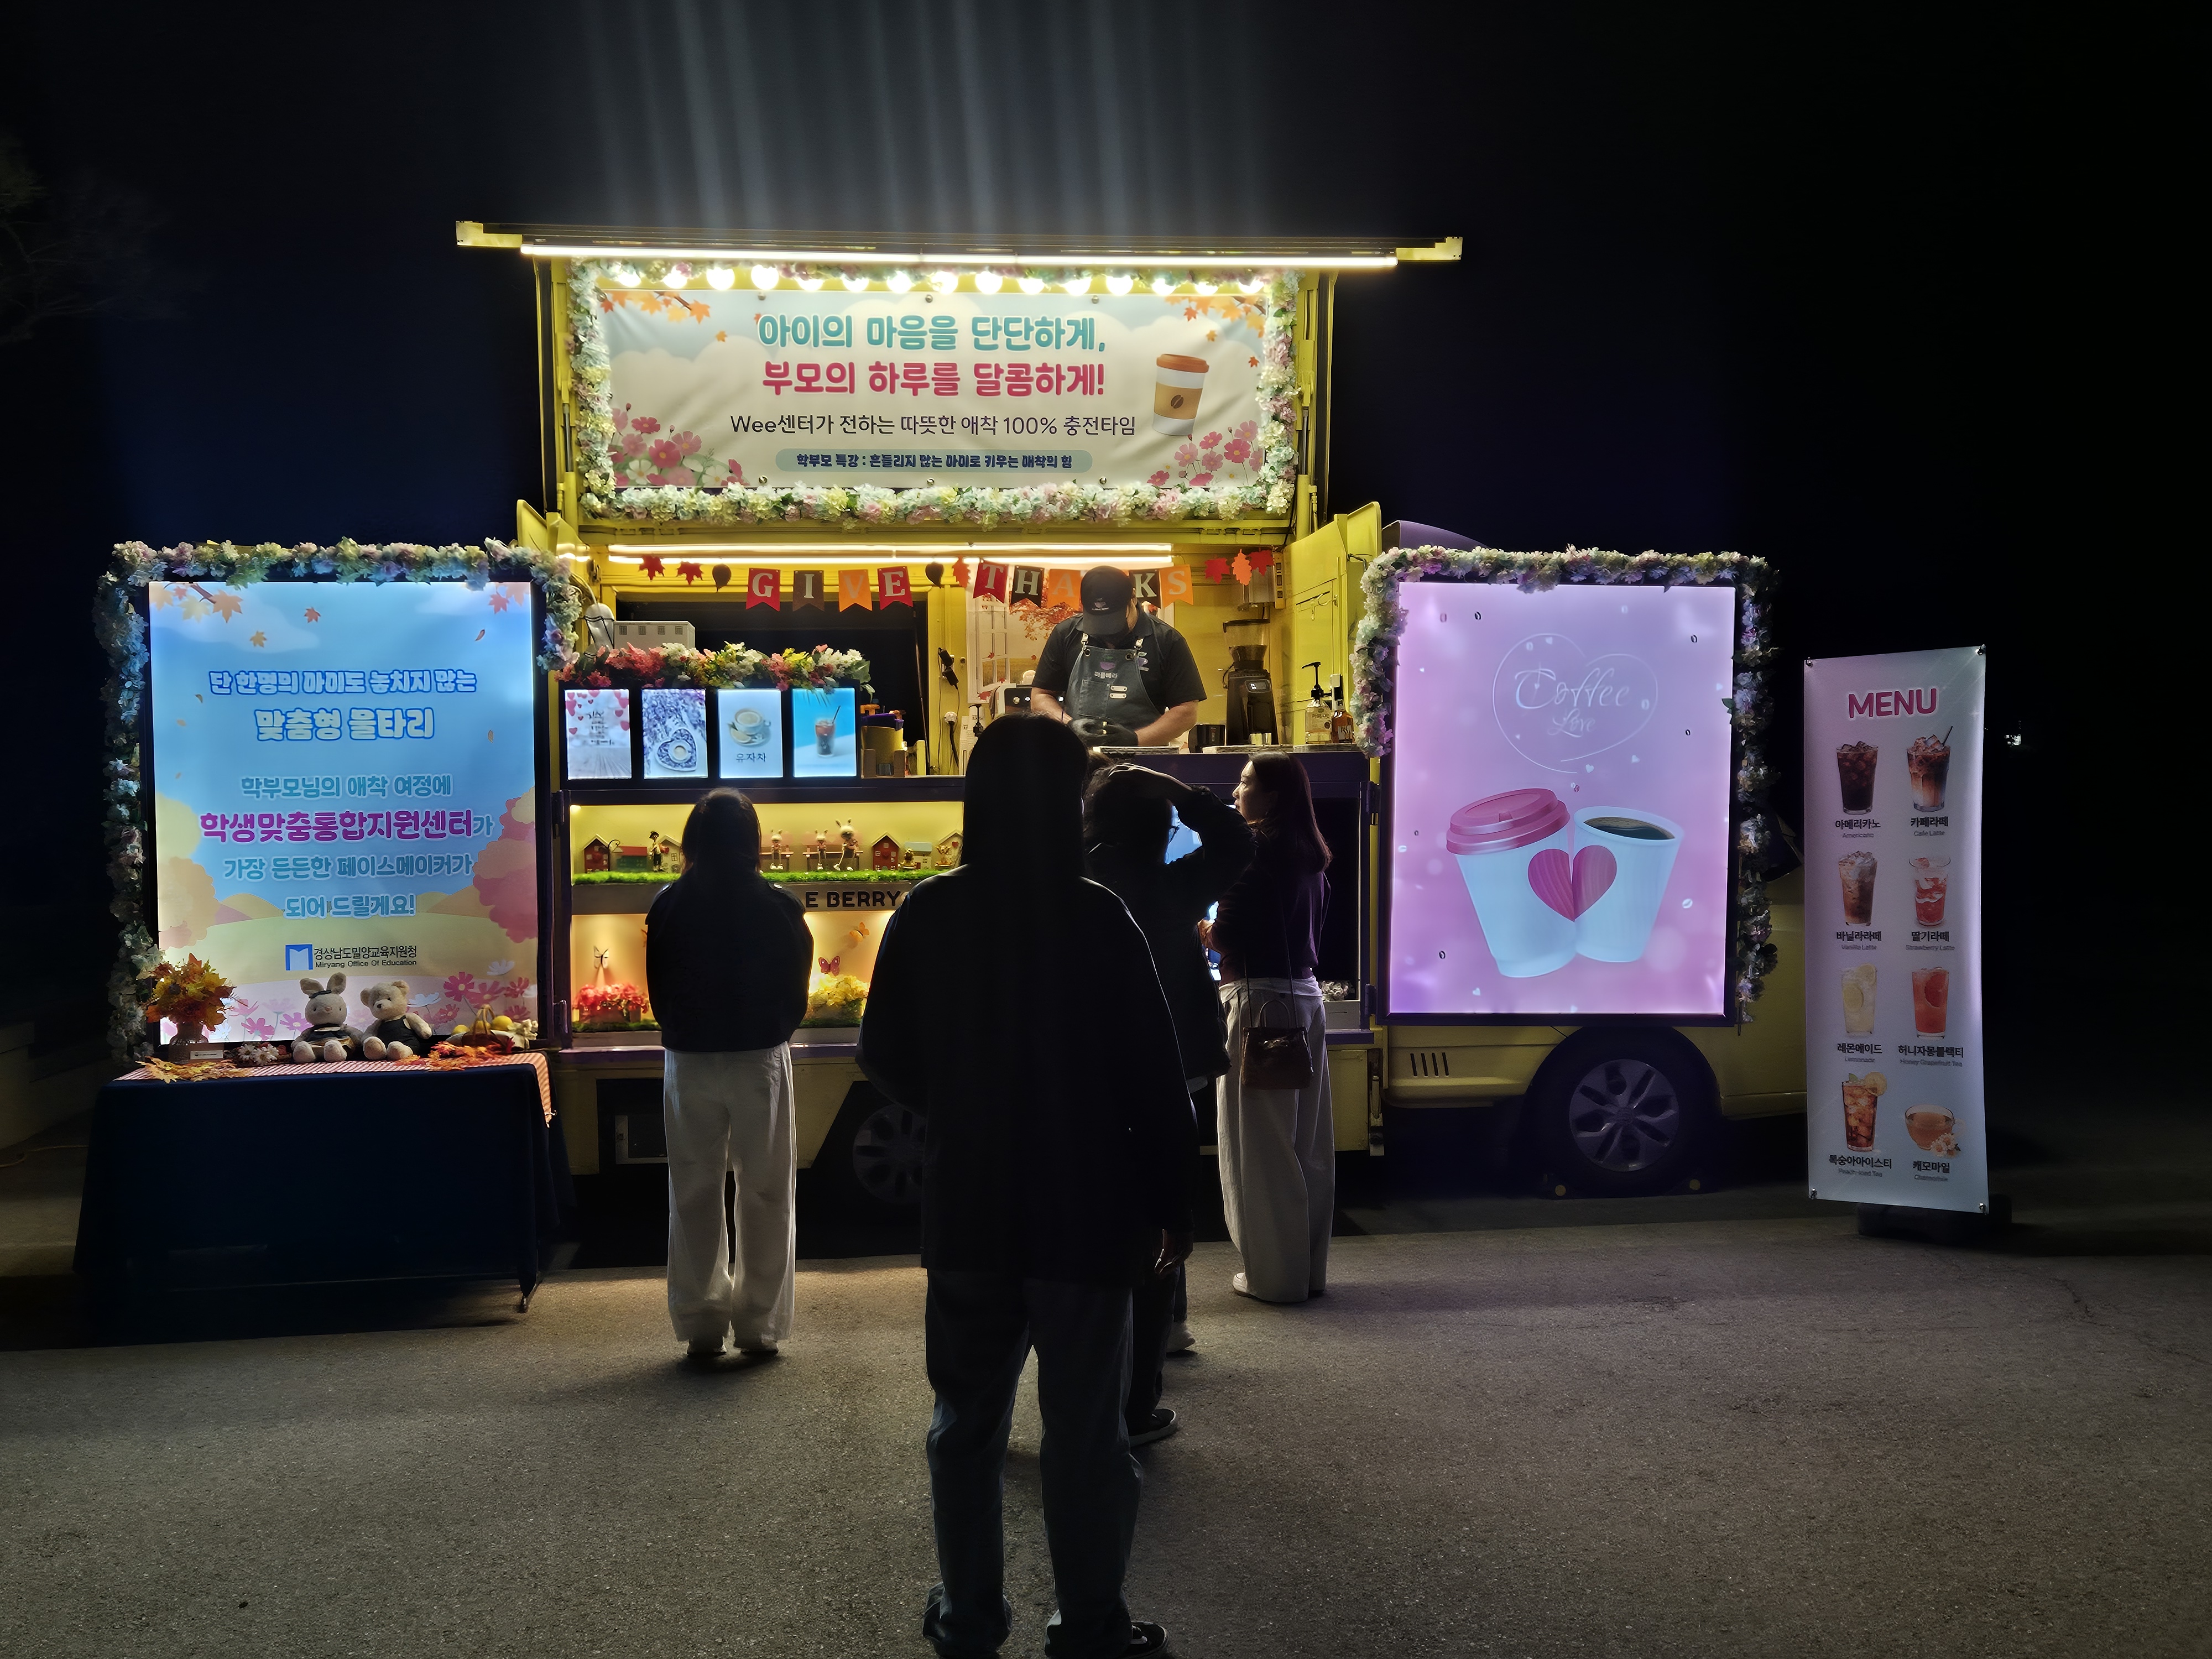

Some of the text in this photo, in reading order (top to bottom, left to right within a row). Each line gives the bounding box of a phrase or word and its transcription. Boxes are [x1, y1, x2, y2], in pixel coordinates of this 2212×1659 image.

[759, 314, 1105, 352] 아이의 마음을 단단하게,
[763, 361, 1104, 397] 부모의 하루를 달콤하게!
[730, 415, 1135, 436] Wee센터가 전하는 따뜻한 애착 100% 충전타임
[796, 453, 832, 467] 학부모
[836, 453, 859, 467] 특강
[870, 453, 916, 468] 흔들리지
[920, 454, 942, 468] 않는
[946, 455, 981, 468] 아이로
[984, 455, 1019, 468] 키우는
[1022, 455, 1057, 468] 애착의
[1061, 455, 1072, 468] 힘
[753, 563, 1187, 599] GIVE THAKS
[208, 669, 477, 695] 단 한명의 아이도 놓치지 않는
[1515, 667, 1630, 709] Coffee
[1848, 687, 1937, 718] MENU
[254, 707, 435, 741] 맞춤형 울타리
[1548, 708, 1595, 738] Love
[241, 774, 452, 799] 학부모님의 애착 여정에
[200, 809, 494, 843] 학생맞춤통합지원센터가
[1835, 818, 1881, 830] 아메리카노
[1910, 816, 1948, 828] 카페라떼
[225, 853, 473, 880] 가장 든든한 페이스메이커가
[285, 894, 415, 918] 되어 드릴게요!
[827, 890, 901, 907] BERRY
[1837, 931, 1882, 942] 바닐라라떼
[1911, 931, 1949, 942] 딸기라떼
[314, 945, 416, 960] 경상남도밀양교육지원청
[1837, 1043, 1883, 1054] 레몬에이드
[1829, 1155, 1892, 1169] 복숭아아이스티
[1912, 1161, 1950, 1173] 캐모마일
